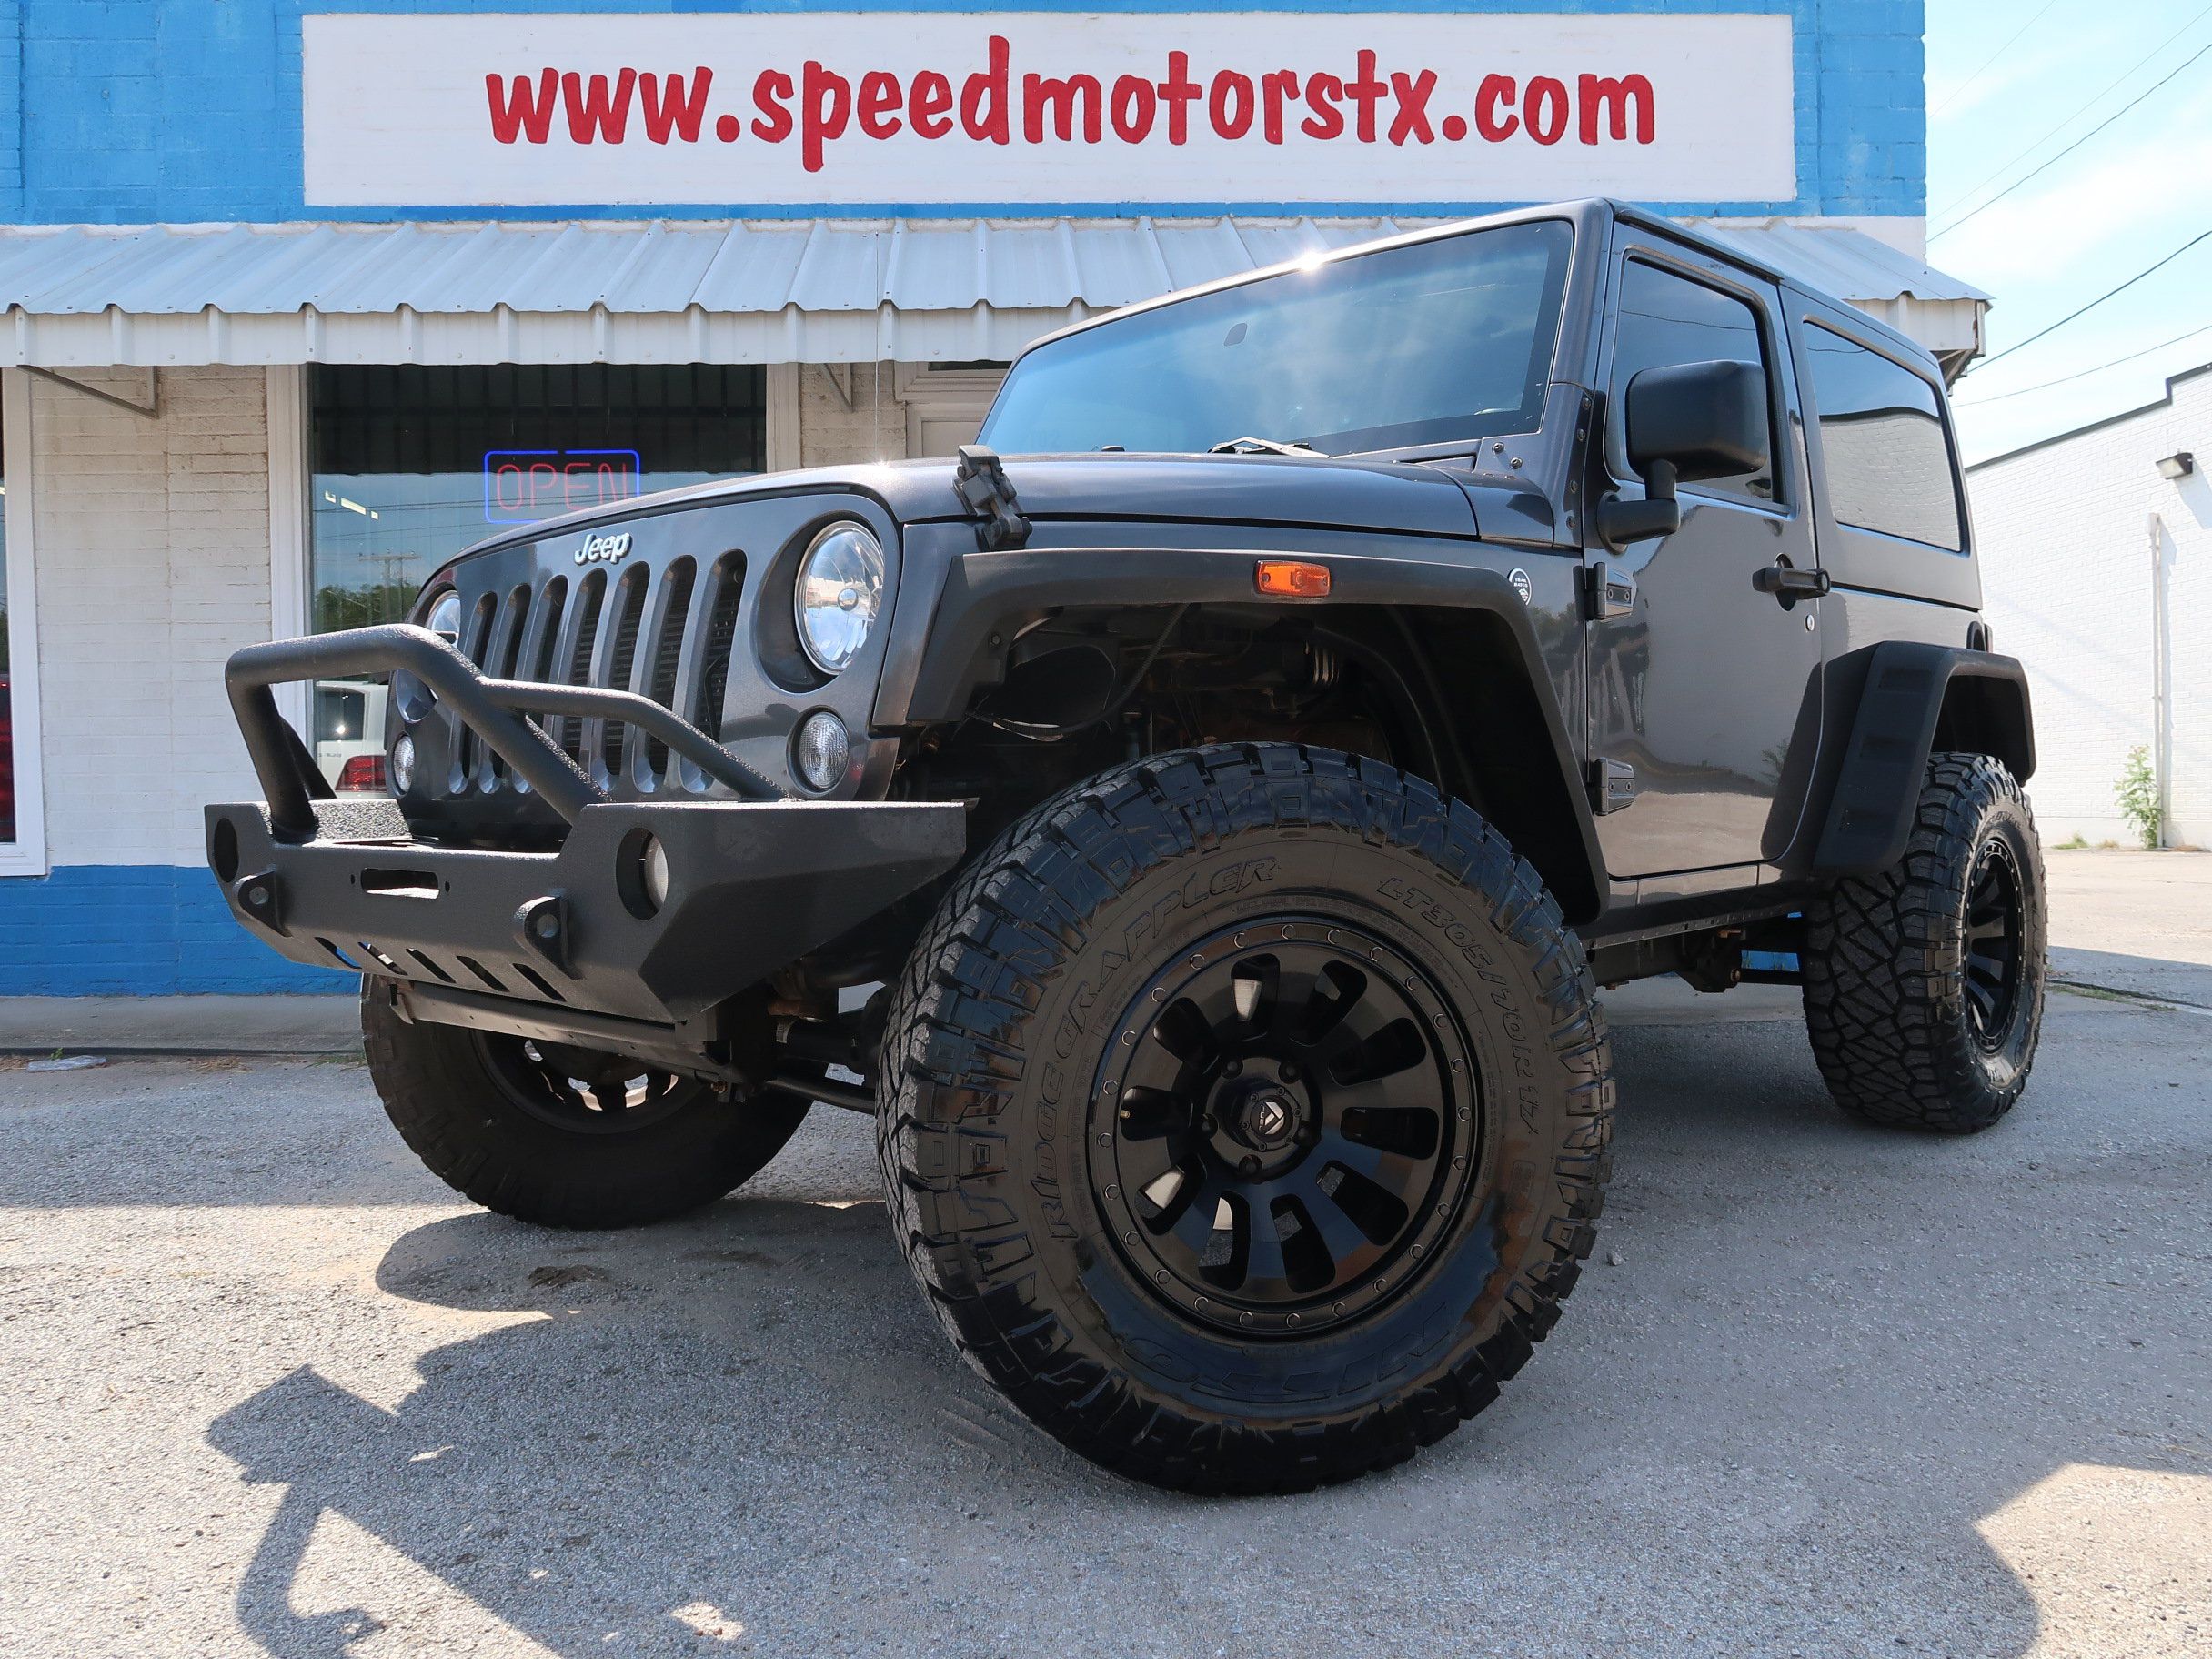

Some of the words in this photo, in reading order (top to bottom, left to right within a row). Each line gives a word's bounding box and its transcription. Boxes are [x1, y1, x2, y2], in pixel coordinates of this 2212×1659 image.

[486, 35, 1654, 172] www.speedmotorstx.com
[496, 462, 628, 510] OPEN
[574, 532, 632, 565] Jeep
[1054, 856, 1280, 1059] GRAPPLER
[1030, 1061, 1081, 1240] RIDGE
